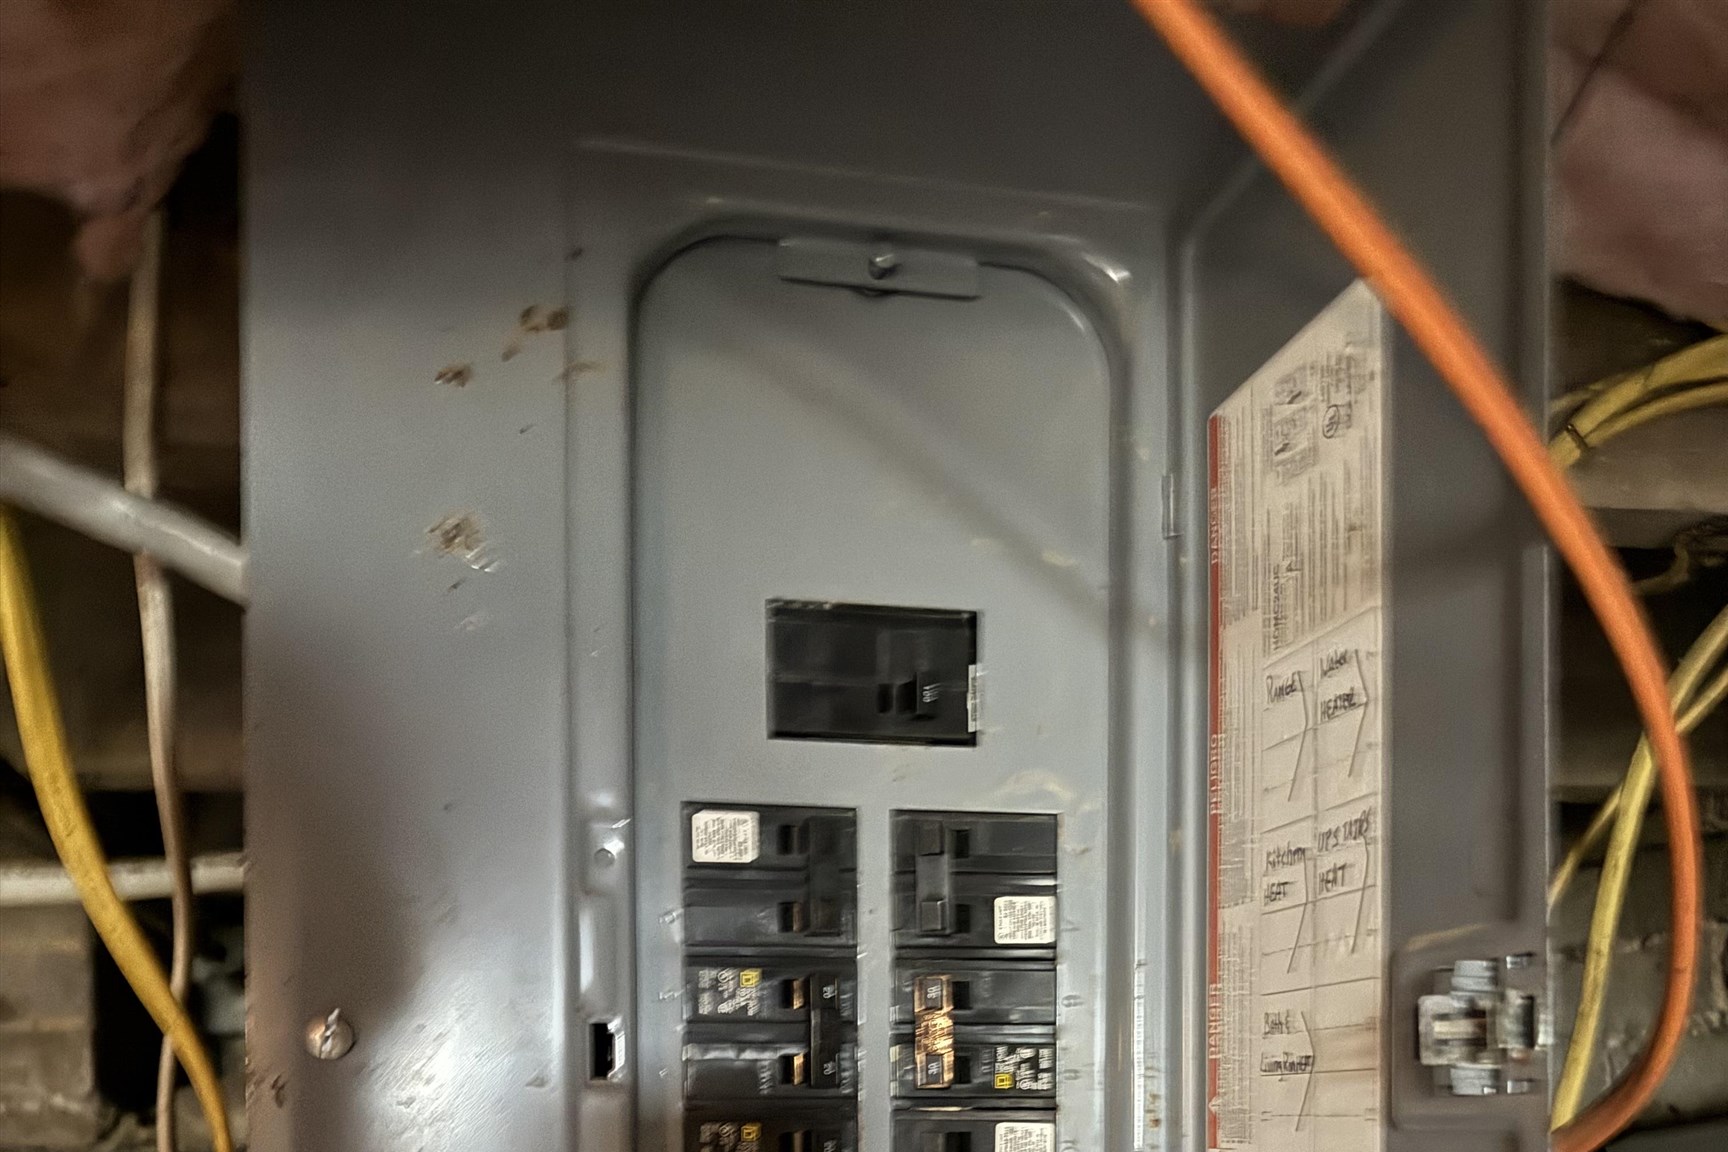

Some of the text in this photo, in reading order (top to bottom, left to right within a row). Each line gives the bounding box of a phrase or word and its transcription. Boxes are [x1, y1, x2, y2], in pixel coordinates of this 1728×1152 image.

[1210, 488, 1219, 564] DANGER
[1210, 734, 1219, 814] PELIGRO
[1264, 880, 1291, 906] HEAT
[1319, 863, 1347, 895] HEAT
[1209, 984, 1220, 1059] DANGER
